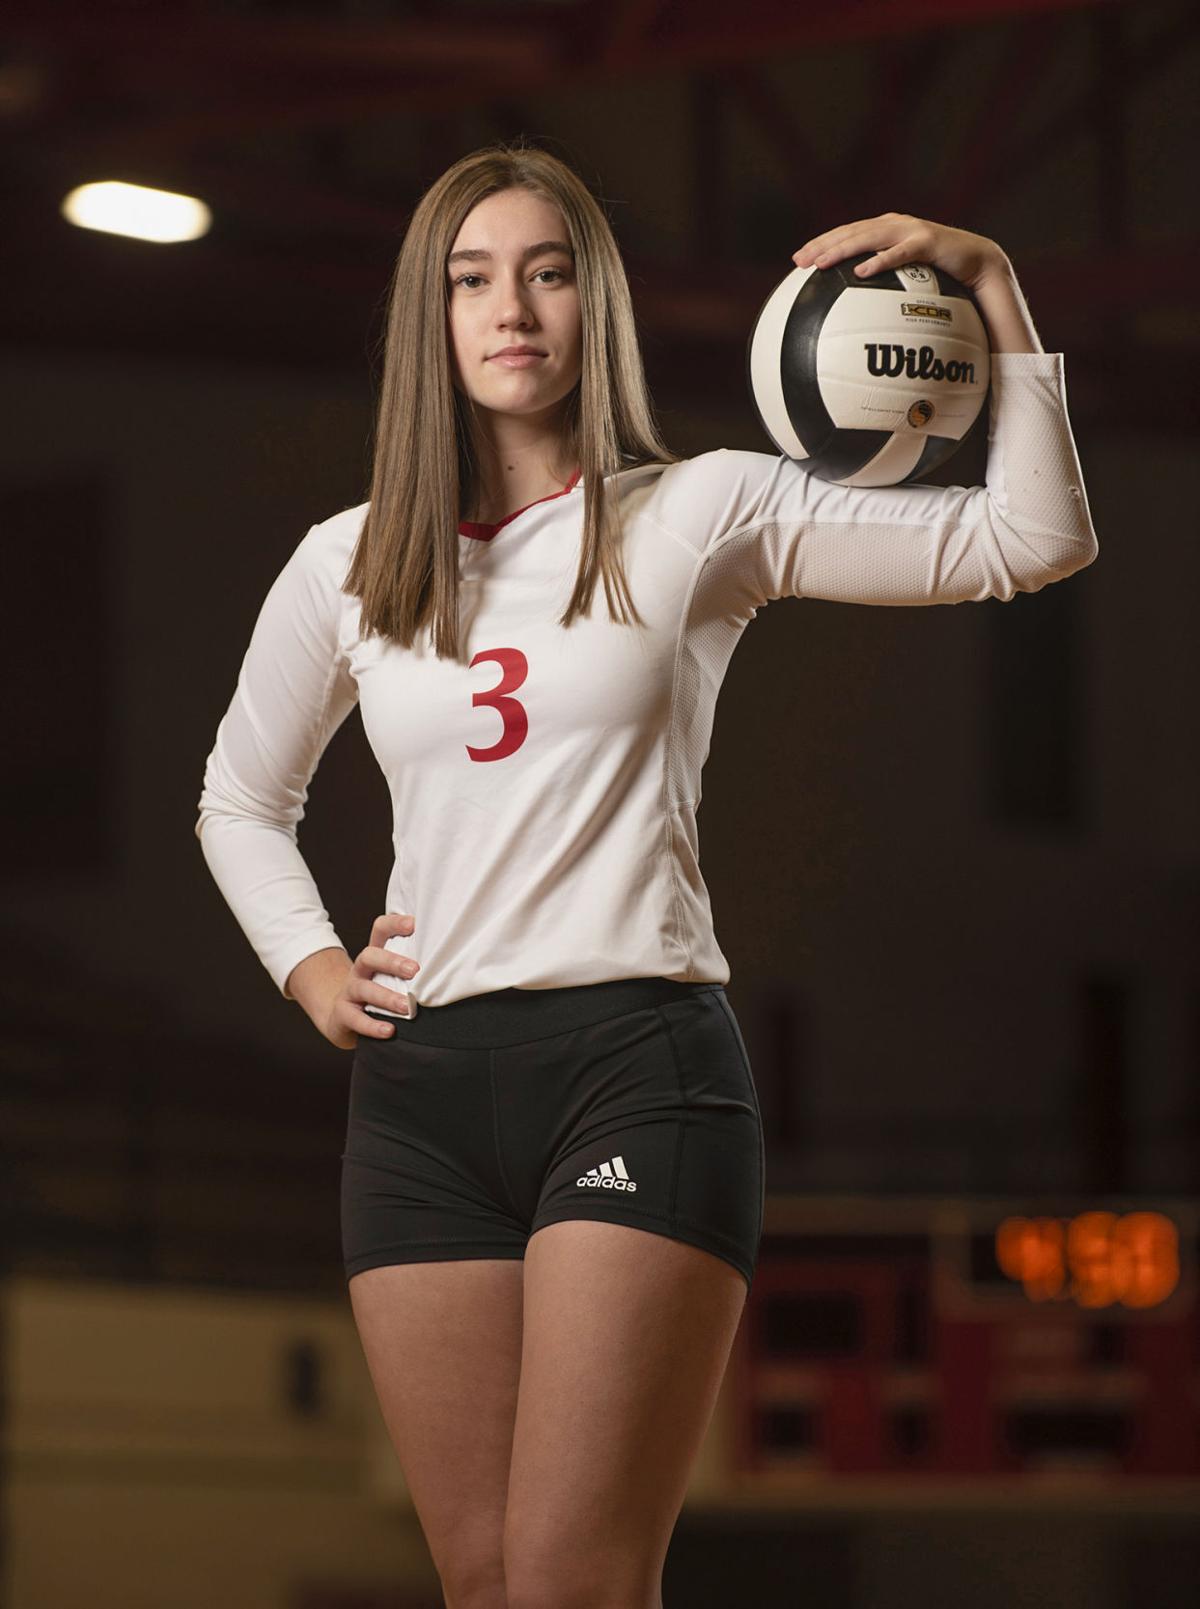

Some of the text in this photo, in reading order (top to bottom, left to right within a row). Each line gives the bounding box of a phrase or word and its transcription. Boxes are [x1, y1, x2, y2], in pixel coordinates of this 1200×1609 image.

[864, 343, 975, 384] Wilson
[465, 647, 528, 763] 3
[576, 1175, 637, 1192] adidas
